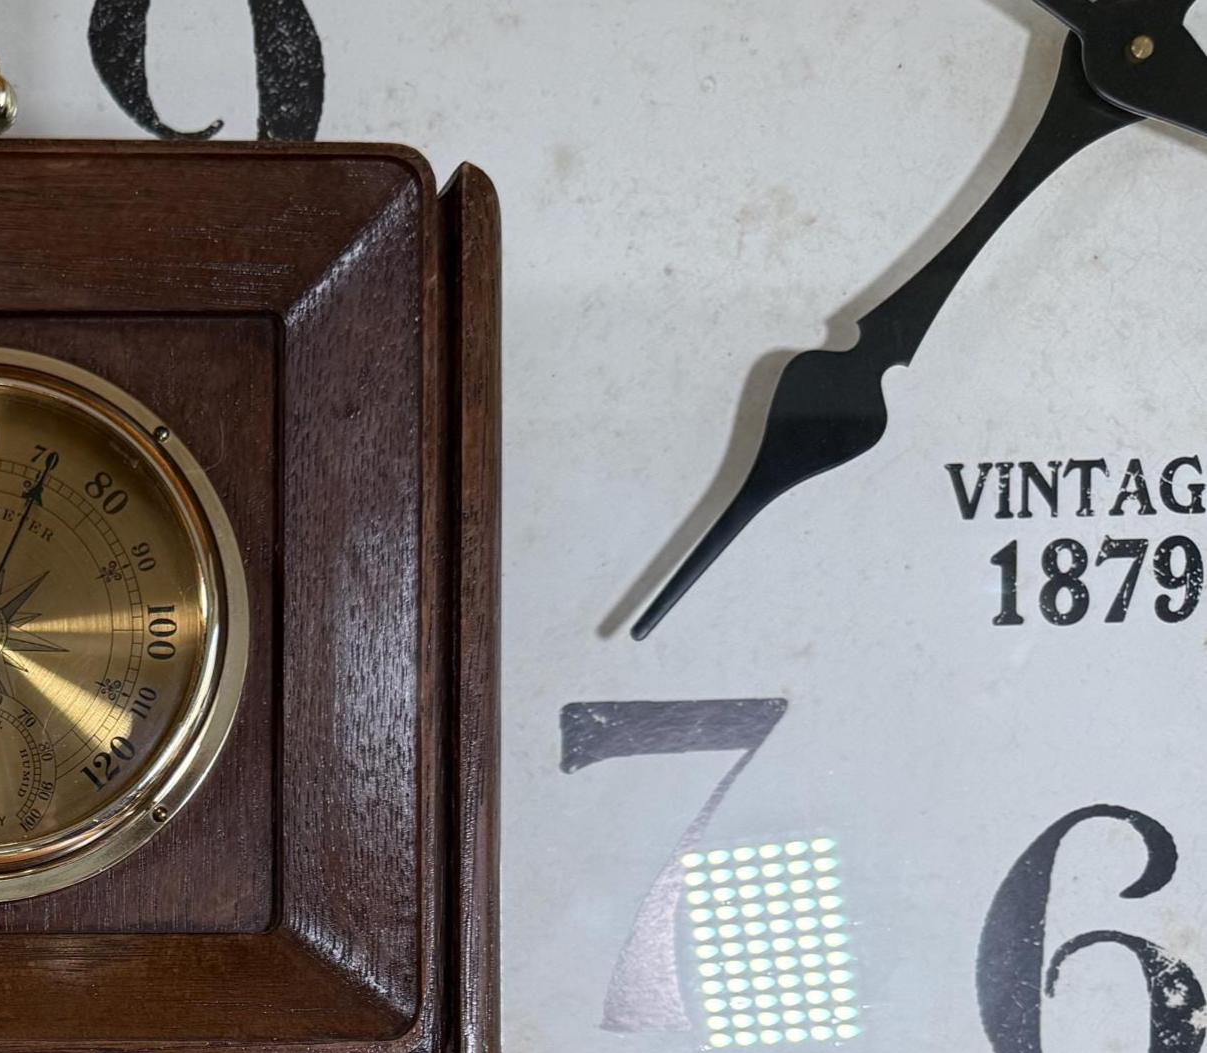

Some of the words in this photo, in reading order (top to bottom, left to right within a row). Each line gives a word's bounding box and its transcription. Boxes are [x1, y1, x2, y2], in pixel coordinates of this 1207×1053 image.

[31, 445, 59, 470] 70
[85, 471, 129, 515] 80
[944, 454, 1206, 520] VINTAG
[131, 542, 156, 572] 90
[990, 535, 1204, 626] 1879
[147, 605, 177, 660] 100
[17, 708, 36, 728] 70
[130, 687, 157, 719] 110
[17, 748, 31, 798] HUMID
[81, 736, 135, 792] 120
[38, 781, 53, 801] 90
[19, 808, 41, 832] 100
[559, 697, 788, 1033] 7
